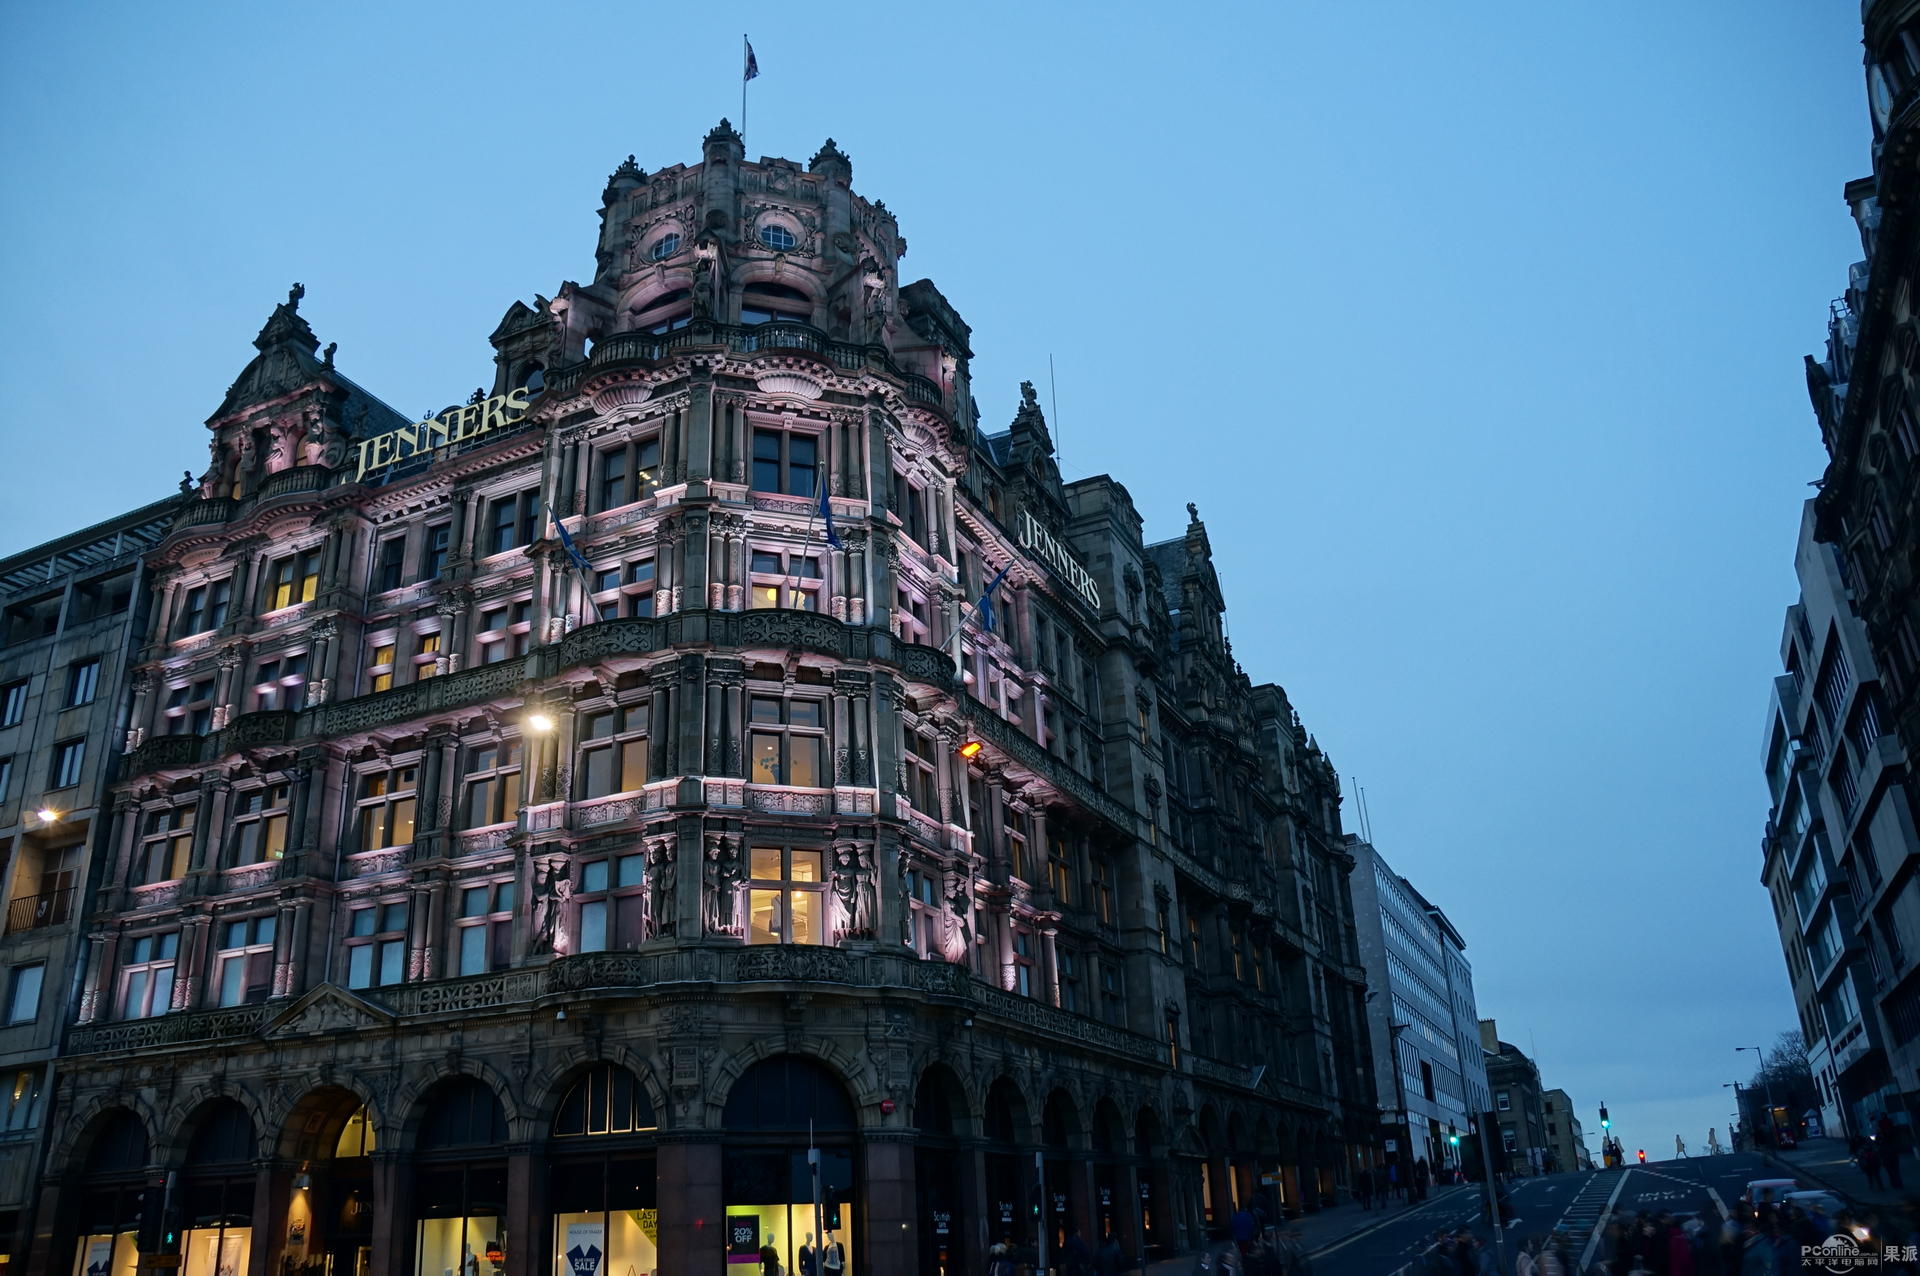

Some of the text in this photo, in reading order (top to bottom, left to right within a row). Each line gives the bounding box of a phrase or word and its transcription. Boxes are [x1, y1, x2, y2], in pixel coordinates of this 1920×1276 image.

[341, 386, 530, 484] JENNERS
[1019, 509, 1101, 609] JENNERS
[637, 1211, 656, 1220] LAST
[643, 1220, 657, 1229] DAY
[734, 1227, 753, 1236] 20%
[735, 1235, 752, 1243] OFF
[574, 1262, 595, 1271] SALE
